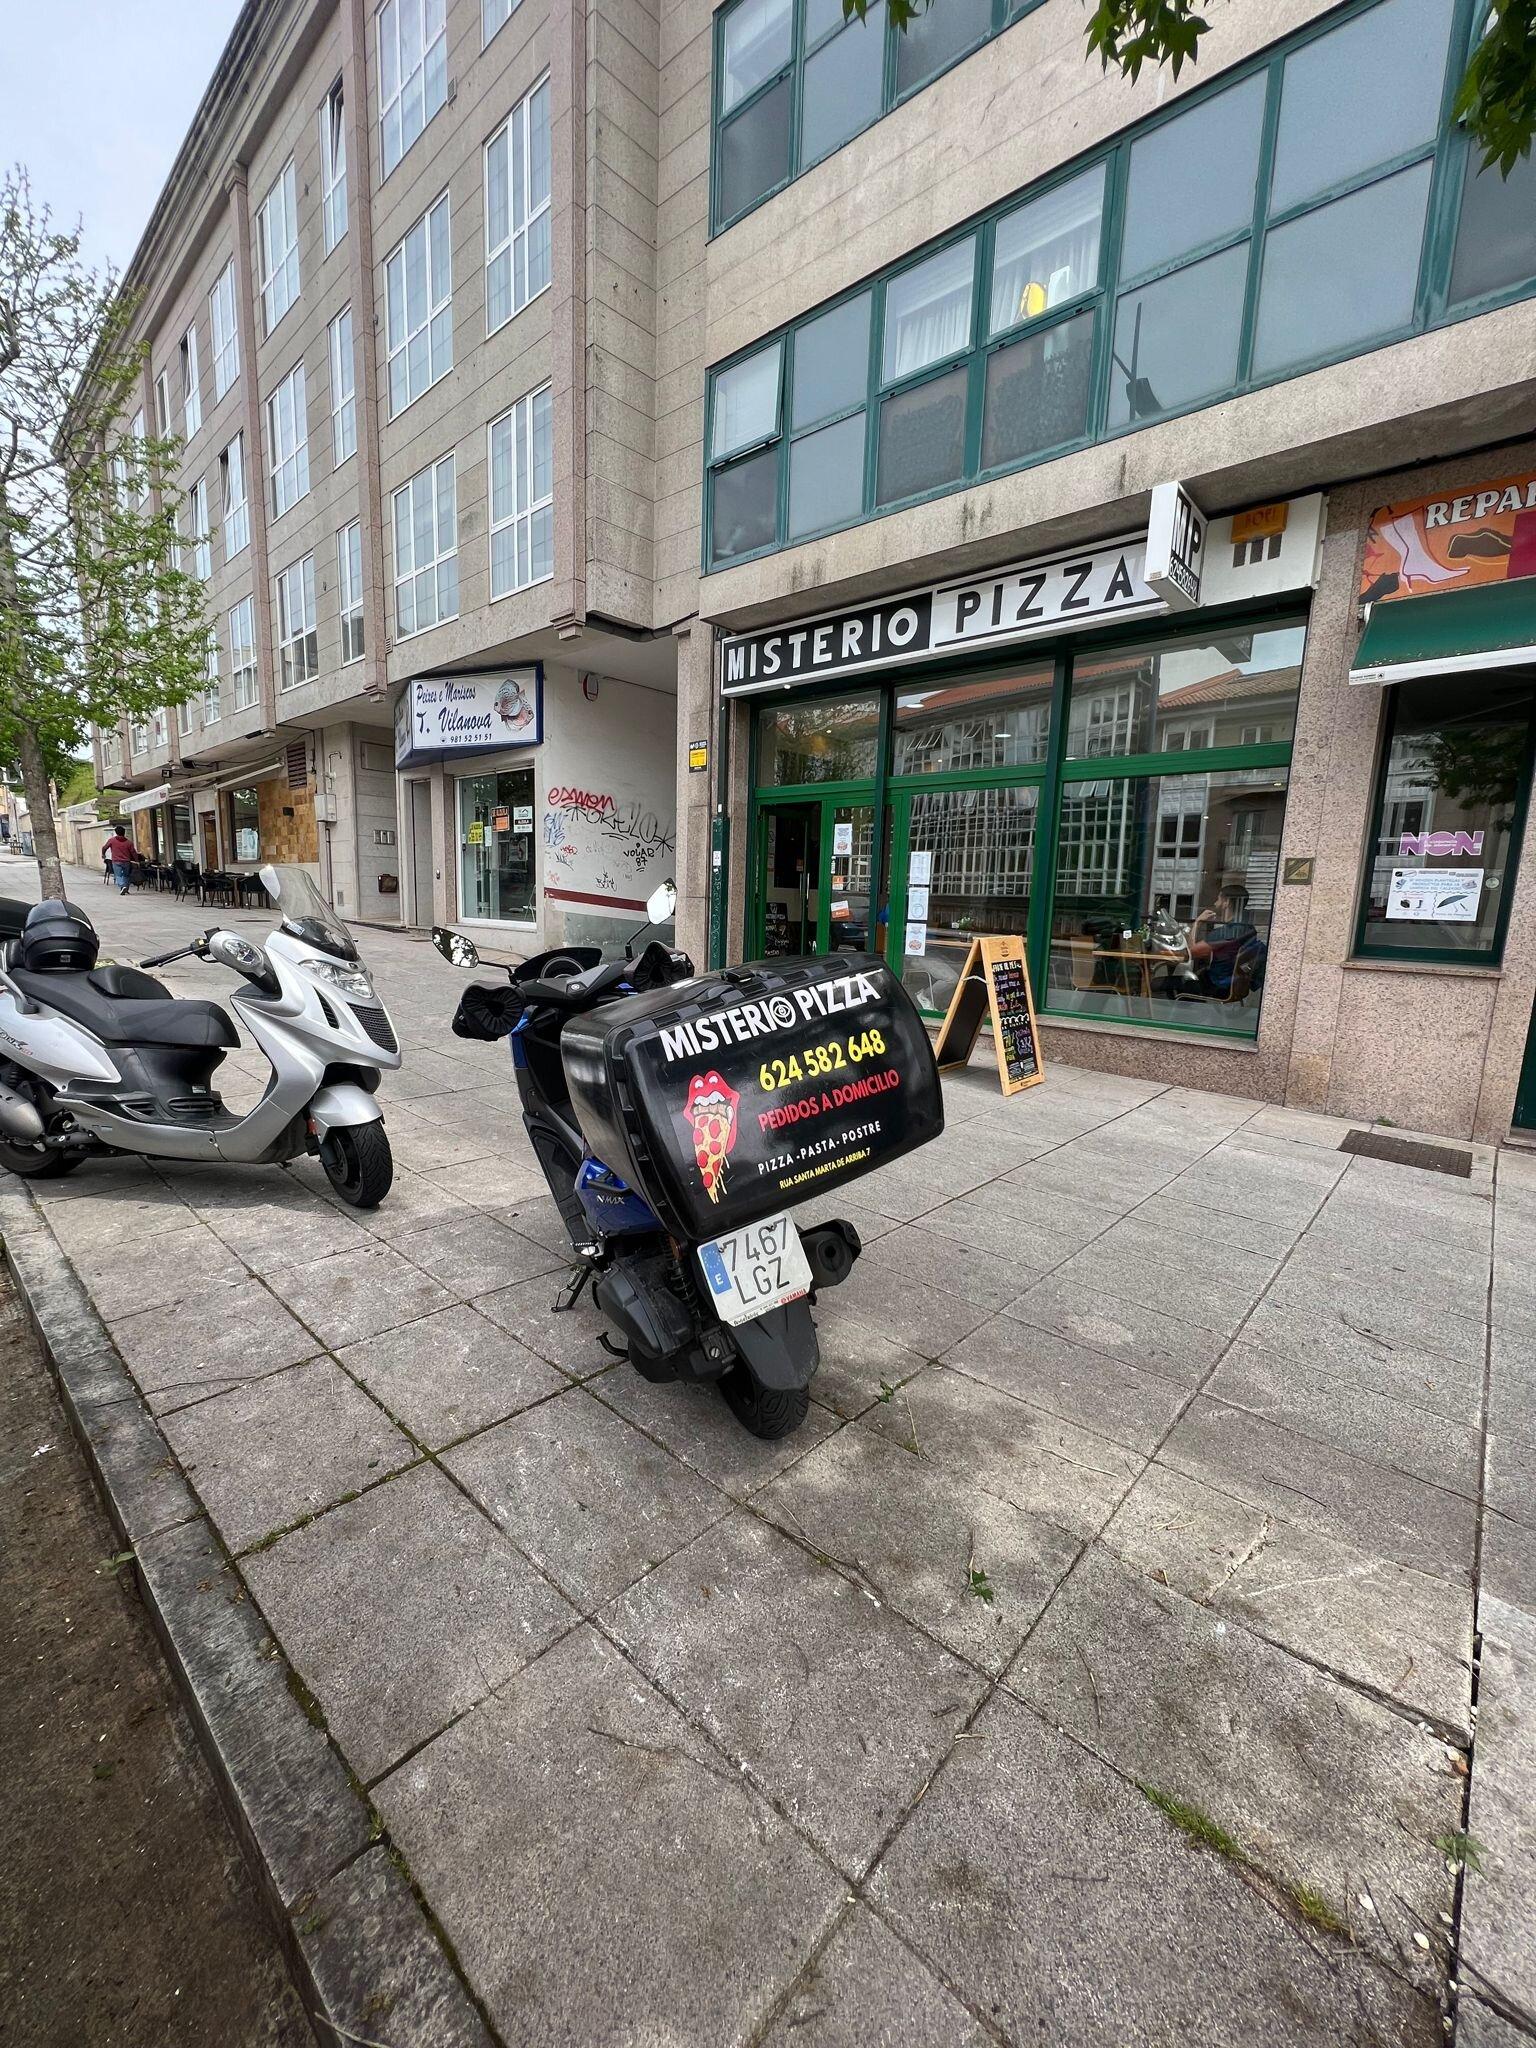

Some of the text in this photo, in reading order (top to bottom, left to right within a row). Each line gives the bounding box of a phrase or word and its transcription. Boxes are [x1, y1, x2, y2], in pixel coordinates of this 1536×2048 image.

[727, 554, 1134, 681] MISTERIO PIZZA
[416, 681, 477, 705] Peixes e Mariscos
[416, 711, 431, 734] T.
[438, 706, 493, 733] Vilanova
[450, 733, 492, 743] 981 52 51 51
[658, 973, 882, 1062] MISTERIO PIZZA
[759, 1028, 886, 1091] 624 582 648
[758, 1069, 900, 1132] PEDIDOS A DOMICILIO
[757, 1153, 794, 1175] PIZZA
[841, 1120, 881, 1145] POSTRE
[779, 1147, 871, 1189] RUA SANTA MARTA DE ARRIBA 7
[721, 1217, 787, 1272] 7467
[714, 1273, 724, 1285] E
[734, 1256, 790, 1305] LGZ
